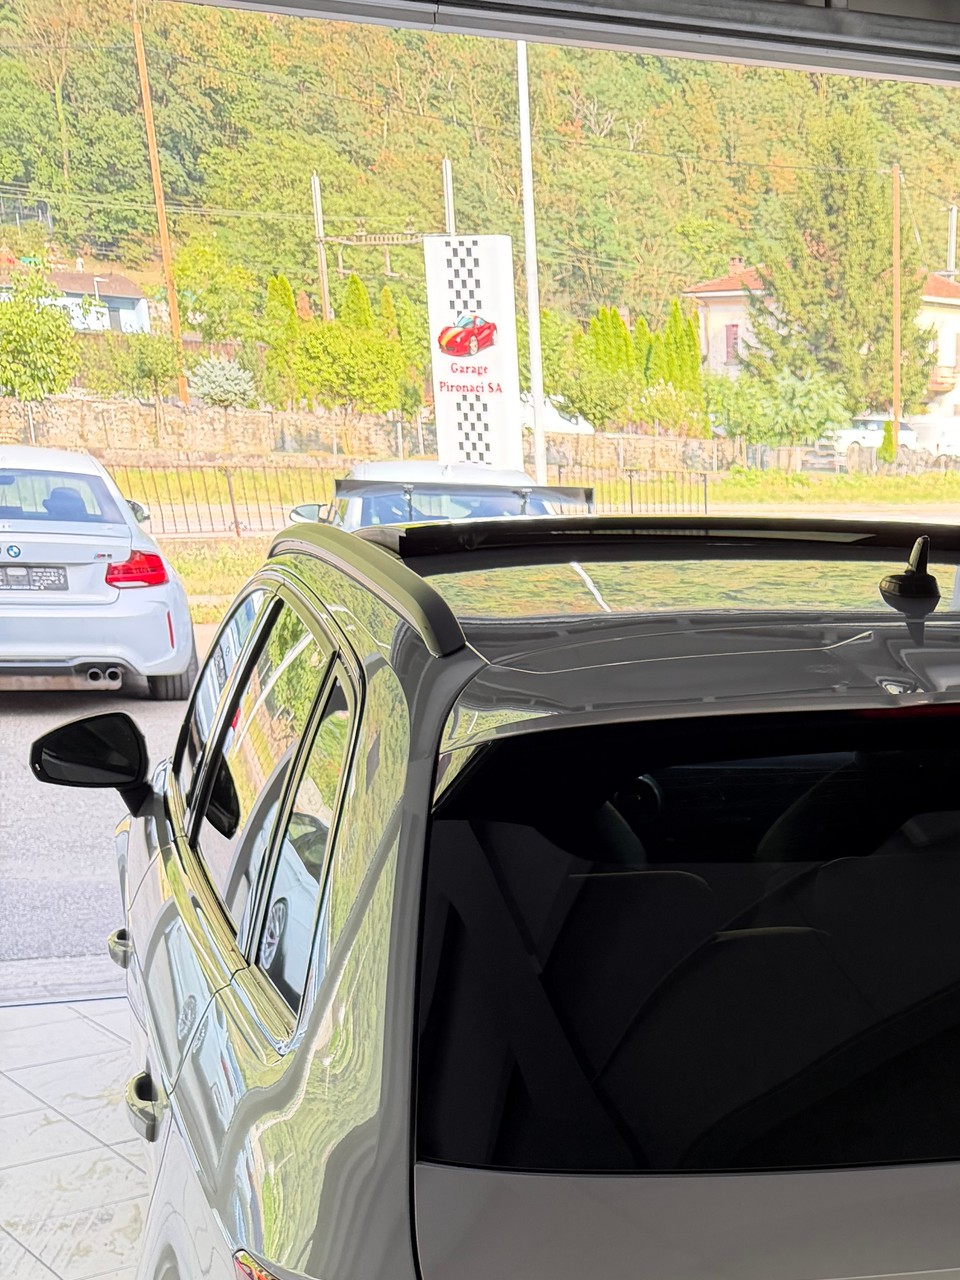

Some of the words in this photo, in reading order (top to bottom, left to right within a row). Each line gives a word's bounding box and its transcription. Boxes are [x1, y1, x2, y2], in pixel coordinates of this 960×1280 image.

[450, 362, 489, 376] Garage
[439, 381, 485, 393] Pironaci
[487, 382, 503, 393] SA
